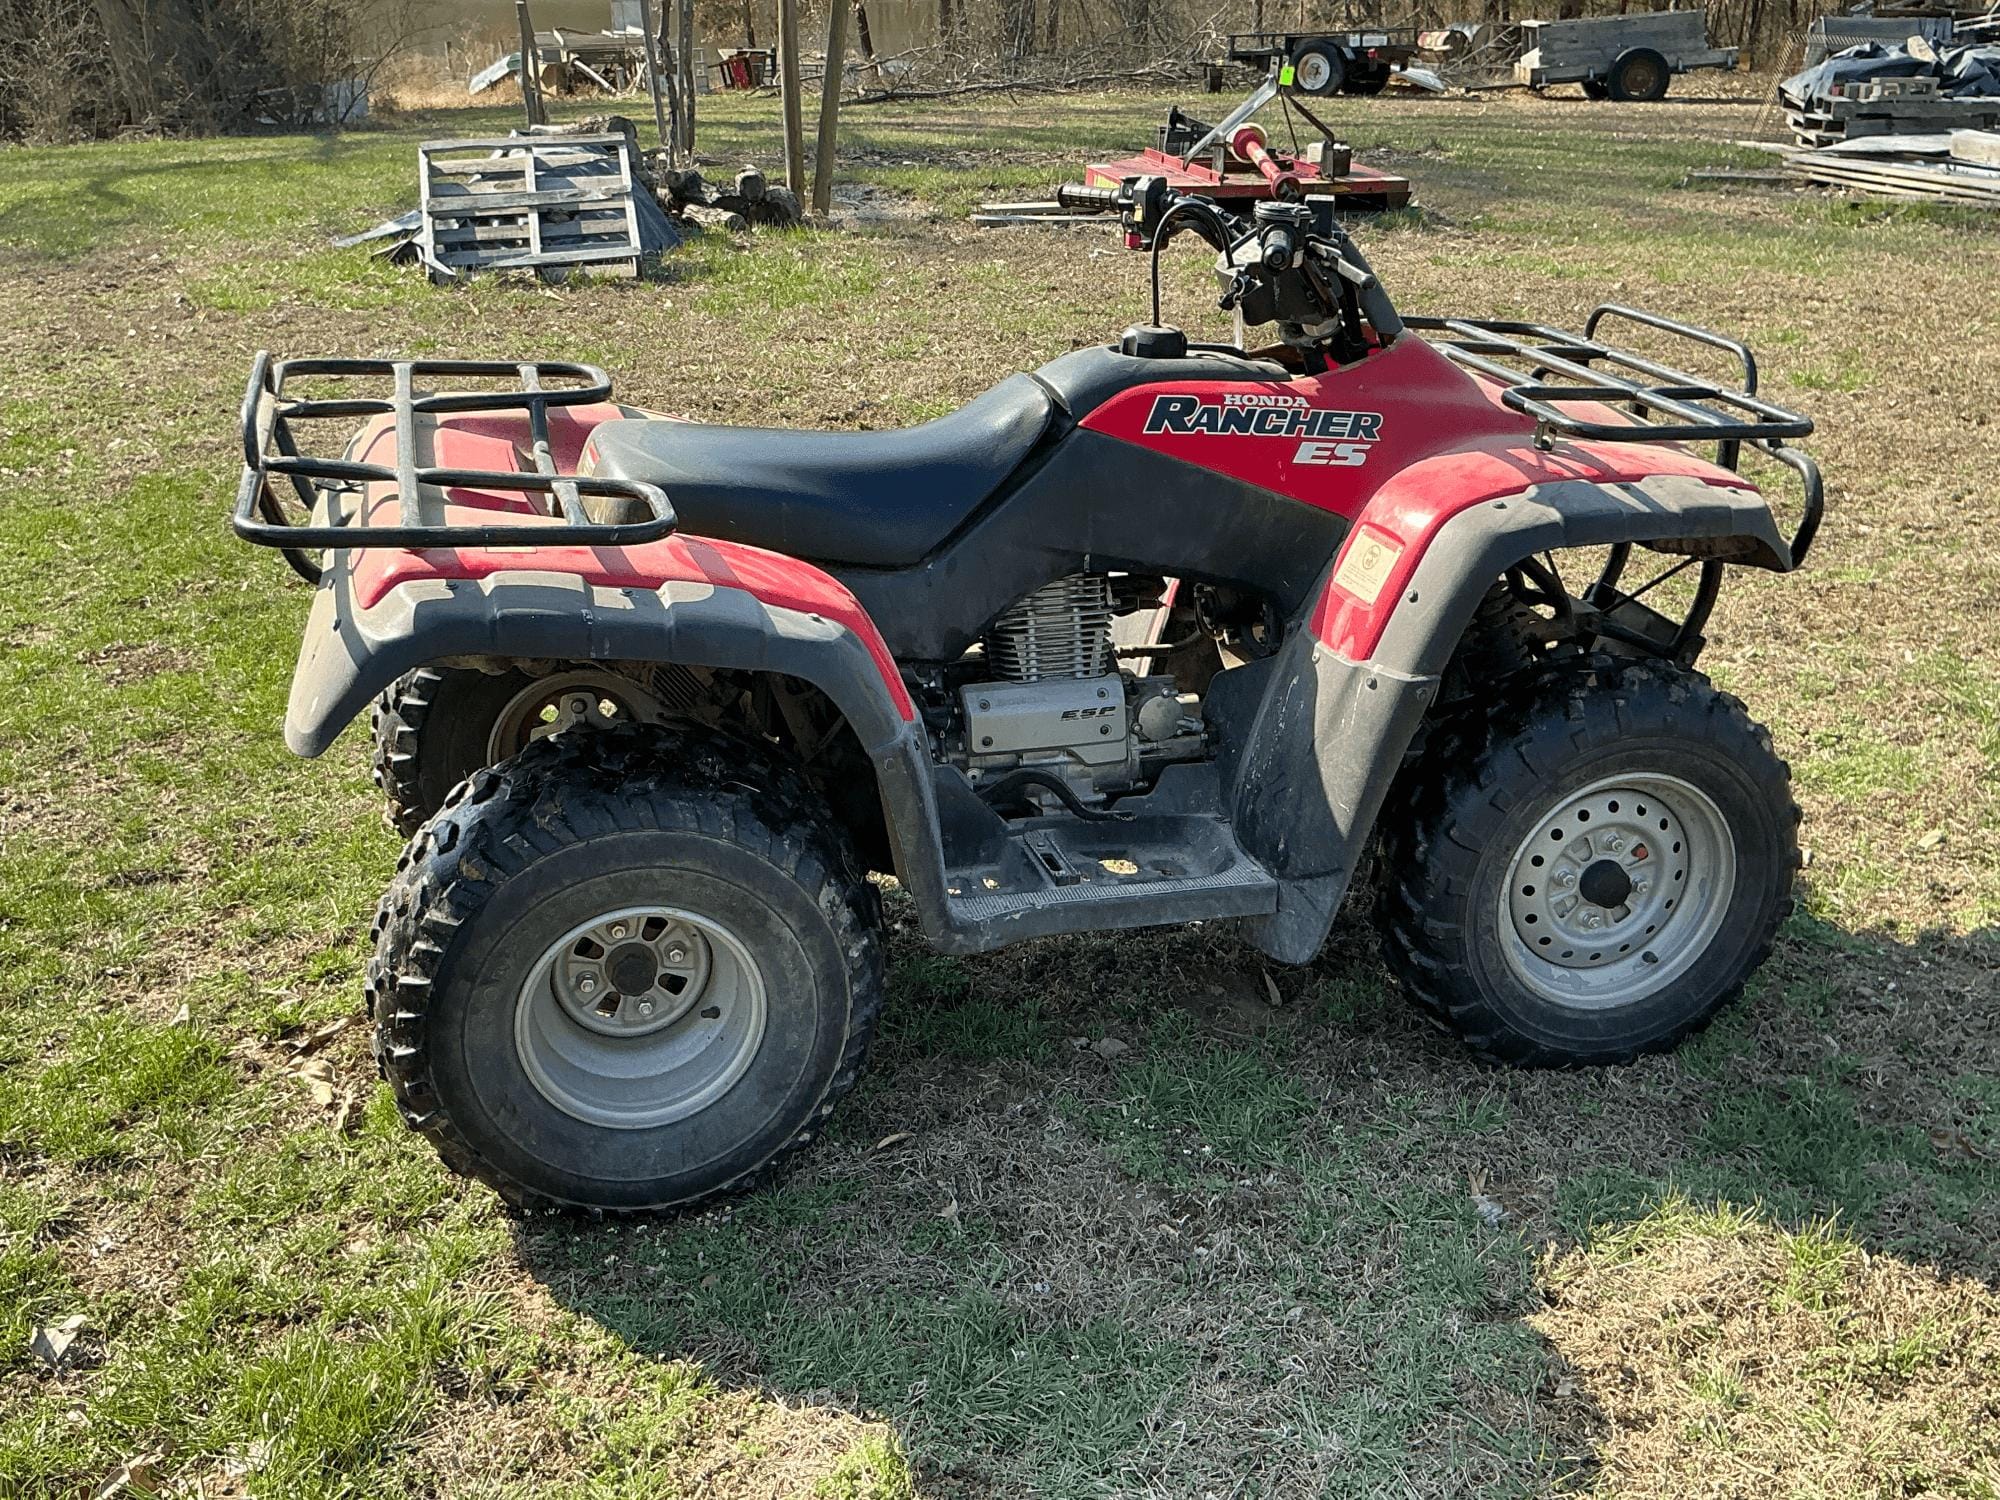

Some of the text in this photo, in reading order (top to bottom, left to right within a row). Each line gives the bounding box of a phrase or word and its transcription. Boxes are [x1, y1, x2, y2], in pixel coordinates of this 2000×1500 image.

[1224, 394, 1310, 407] HONDA
[1143, 395, 1383, 441] RANCHER
[1292, 442, 1372, 466] ES
[1061, 706, 1116, 719] ESP
